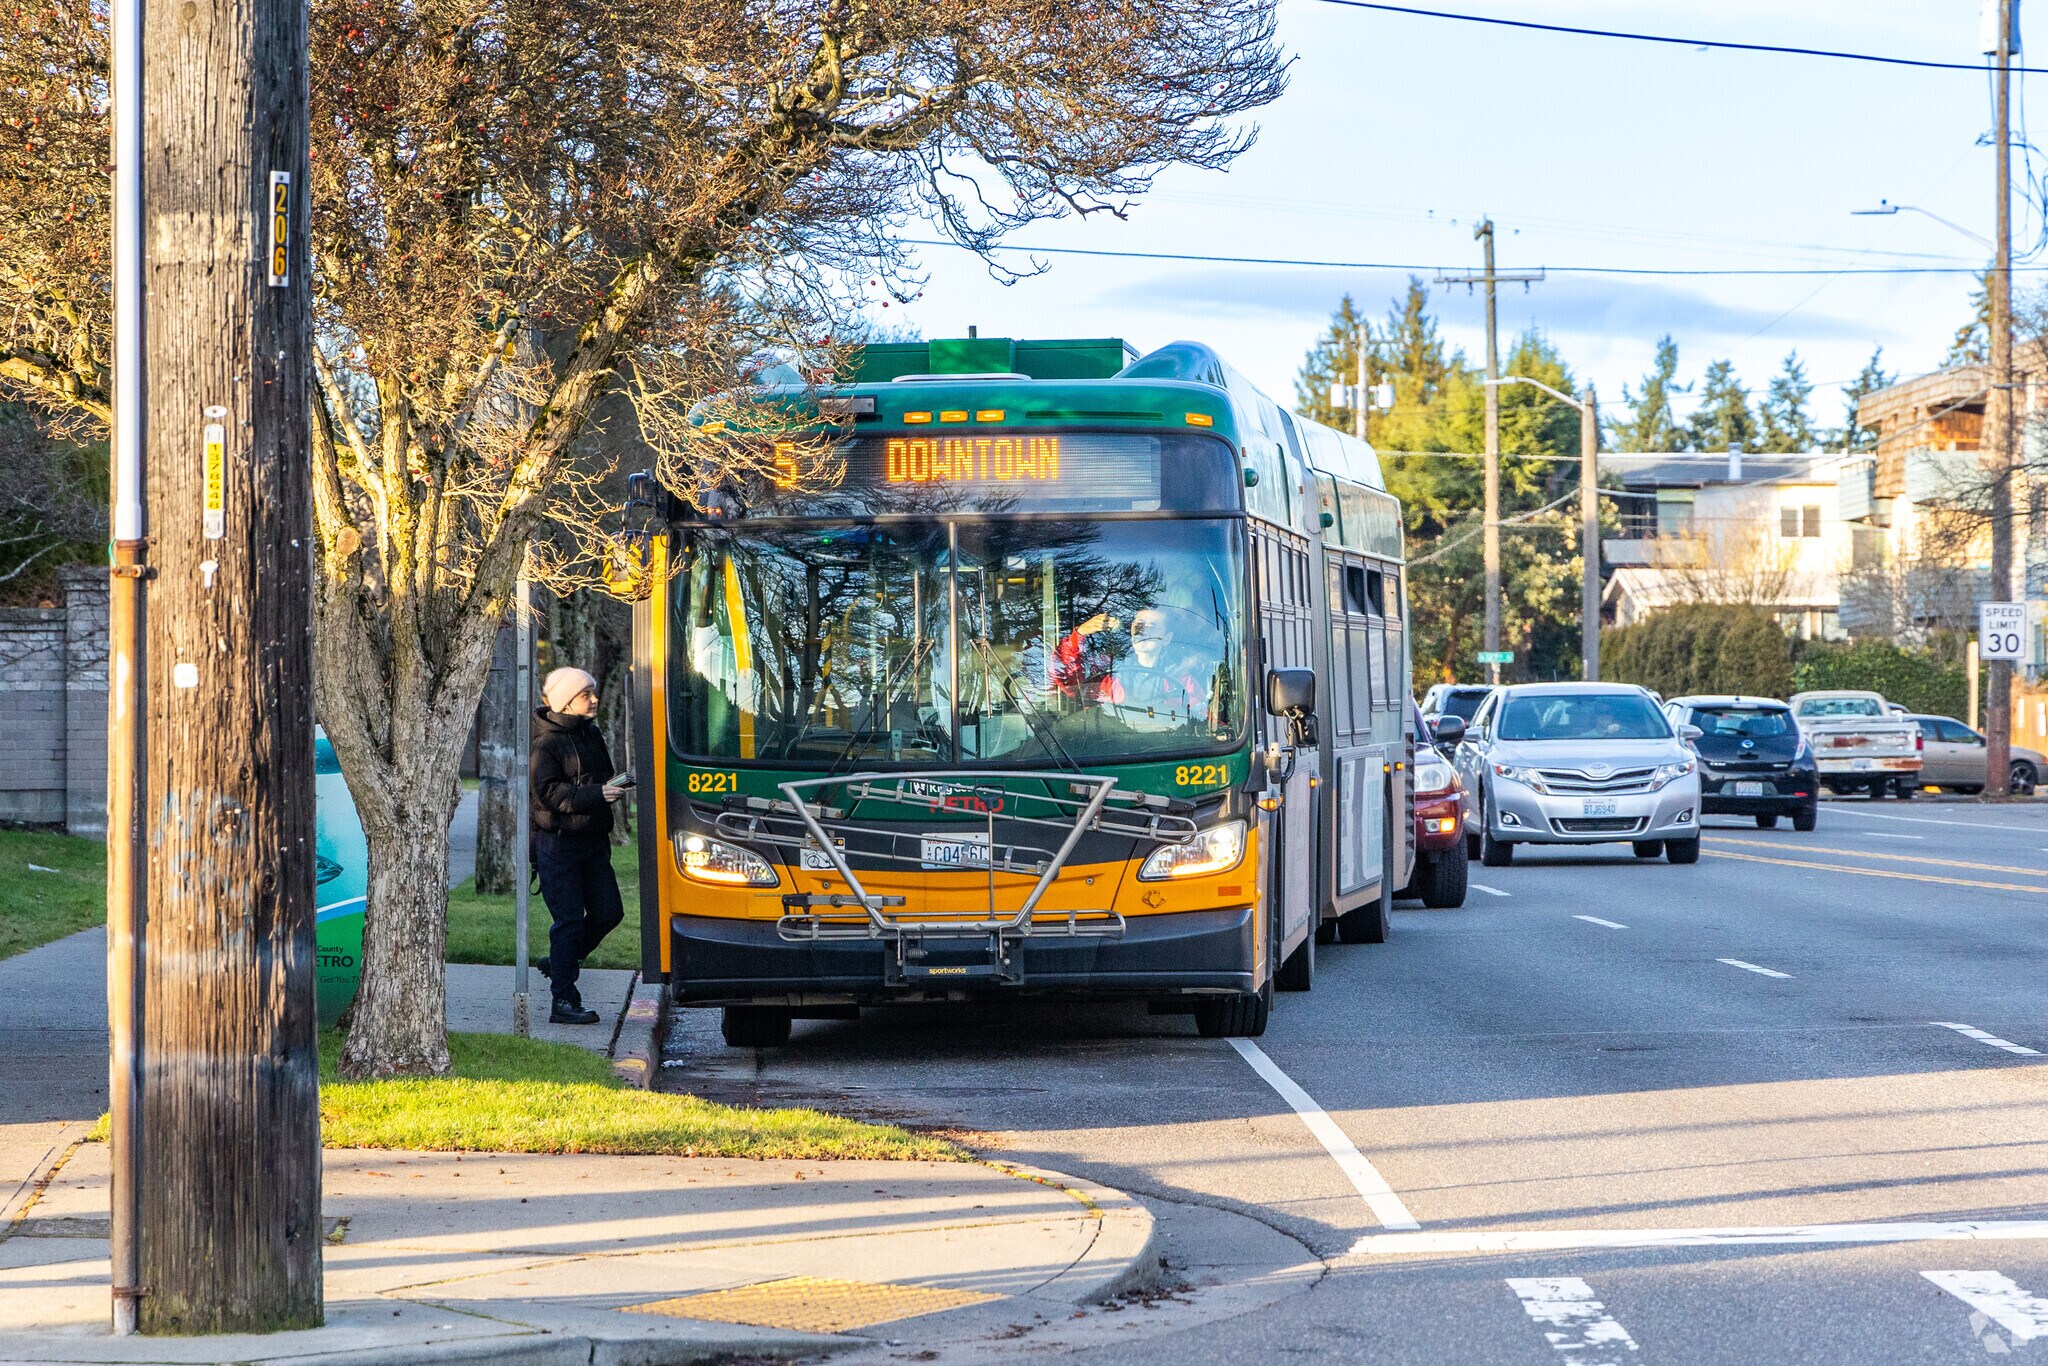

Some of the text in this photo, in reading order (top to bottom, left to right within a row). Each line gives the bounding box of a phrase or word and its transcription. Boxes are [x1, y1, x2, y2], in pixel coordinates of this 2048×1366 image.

[275, 184, 287, 276] 206
[888, 438, 1059, 482] DOWNTOWN
[209, 444, 220, 510] 1378648
[1986, 608, 2022, 617] SPEED
[1989, 621, 2017, 630] LIMIT
[1988, 634, 2019, 652] 30
[688, 773, 737, 792] 8221
[1176, 765, 1226, 785] 8221
[929, 784, 953, 795] Kig
[317, 945, 343, 954] County
[929, 967, 967, 975] sportworks
